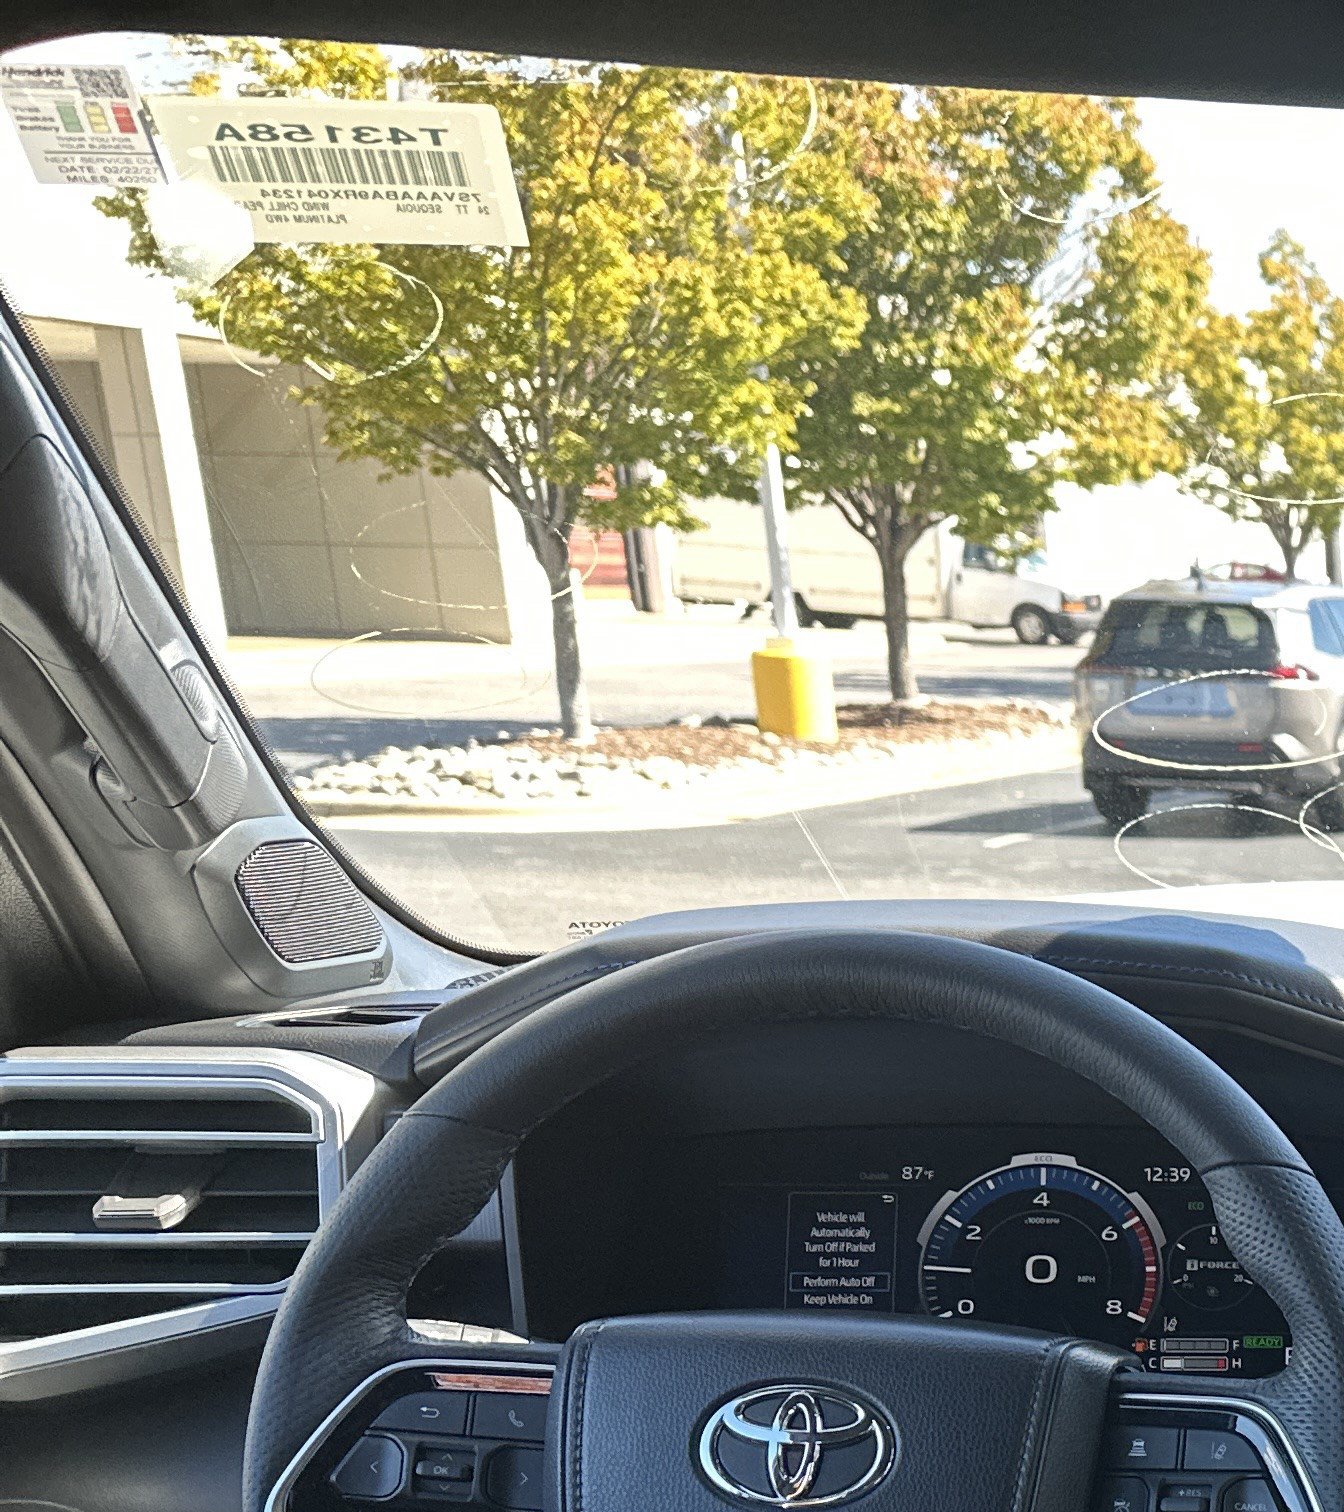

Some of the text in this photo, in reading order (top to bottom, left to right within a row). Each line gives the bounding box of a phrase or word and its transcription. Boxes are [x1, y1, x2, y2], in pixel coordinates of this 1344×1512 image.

[20, 125, 59, 133] Battery
[111, 136, 131, 144] FOR
[44, 156, 155, 165] NEXT SERVICE DU
[1143, 1167, 1192, 1182] 12:39
[1032, 1191, 1051, 1207] 4
[816, 1211, 866, 1223] Vehicle will
[810, 1226, 871, 1239] Automatically
[965, 1225, 982, 1240] 2
[1101, 1226, 1118, 1241] 6
[804, 1241, 876, 1253] Turn Off if Parked
[819, 1257, 830, 1268] for
[838, 1257, 860, 1268] Hour
[1200, 1261, 1239, 1269] FORCE
[1025, 1255, 1058, 1283] 0
[803, 1276, 876, 1287] Perform Auto Off
[1077, 1275, 1096, 1283] MPH
[1233, 1274, 1244, 1282] 20
[803, 1294, 873, 1306] Keep Vehicle On
[957, 1299, 975, 1314] 0
[1106, 1300, 1122, 1315] 8
[1149, 1339, 1240, 1350] E F
[1246, 1338, 1281, 1346] READY
[1148, 1358, 1242, 1369] C H
[433, 1465, 448, 1475] OK
[1234, 1502, 1268, 1512] CANCEL
